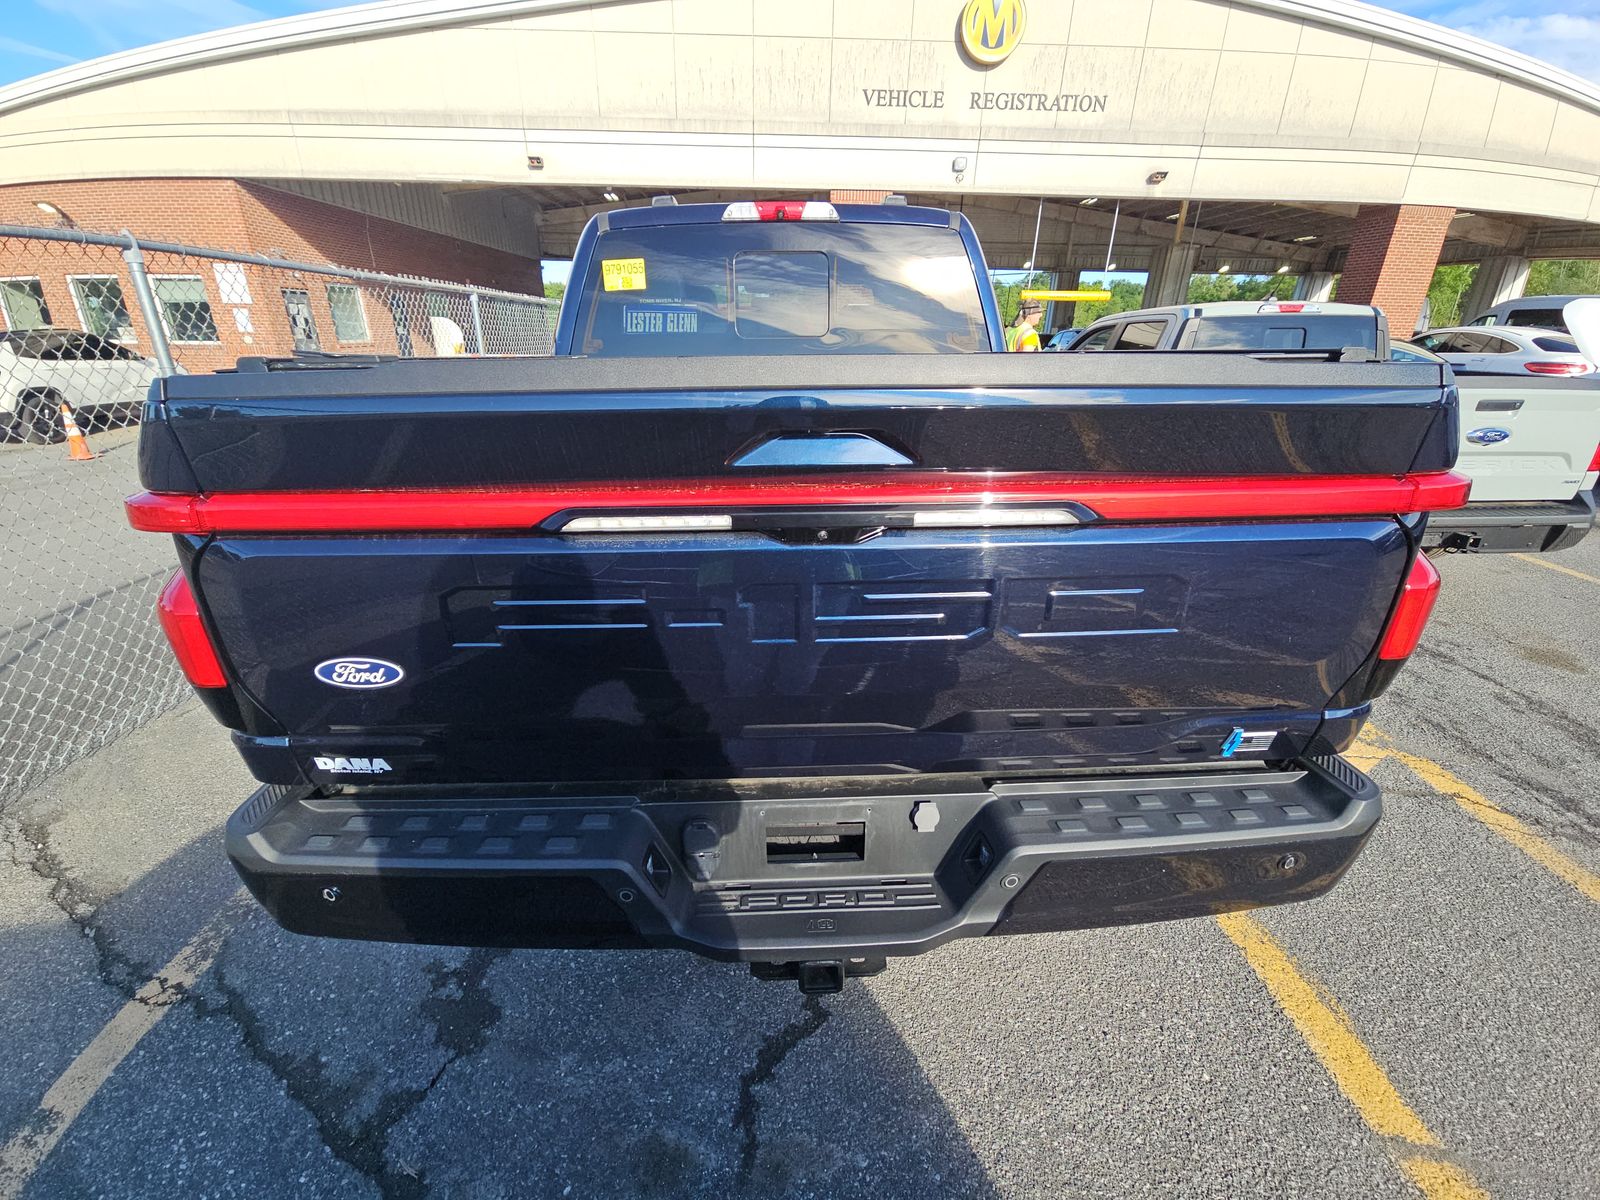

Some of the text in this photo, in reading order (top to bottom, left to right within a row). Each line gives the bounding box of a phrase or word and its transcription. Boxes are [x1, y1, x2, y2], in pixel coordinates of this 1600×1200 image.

[862, 88, 1108, 113] VEHICLE REGISTRATION
[604, 262, 644, 275] 9791055
[626, 311, 697, 333] LESTER GLENN
[313, 757, 392, 771] DANA
[739, 891, 895, 910] FORD
